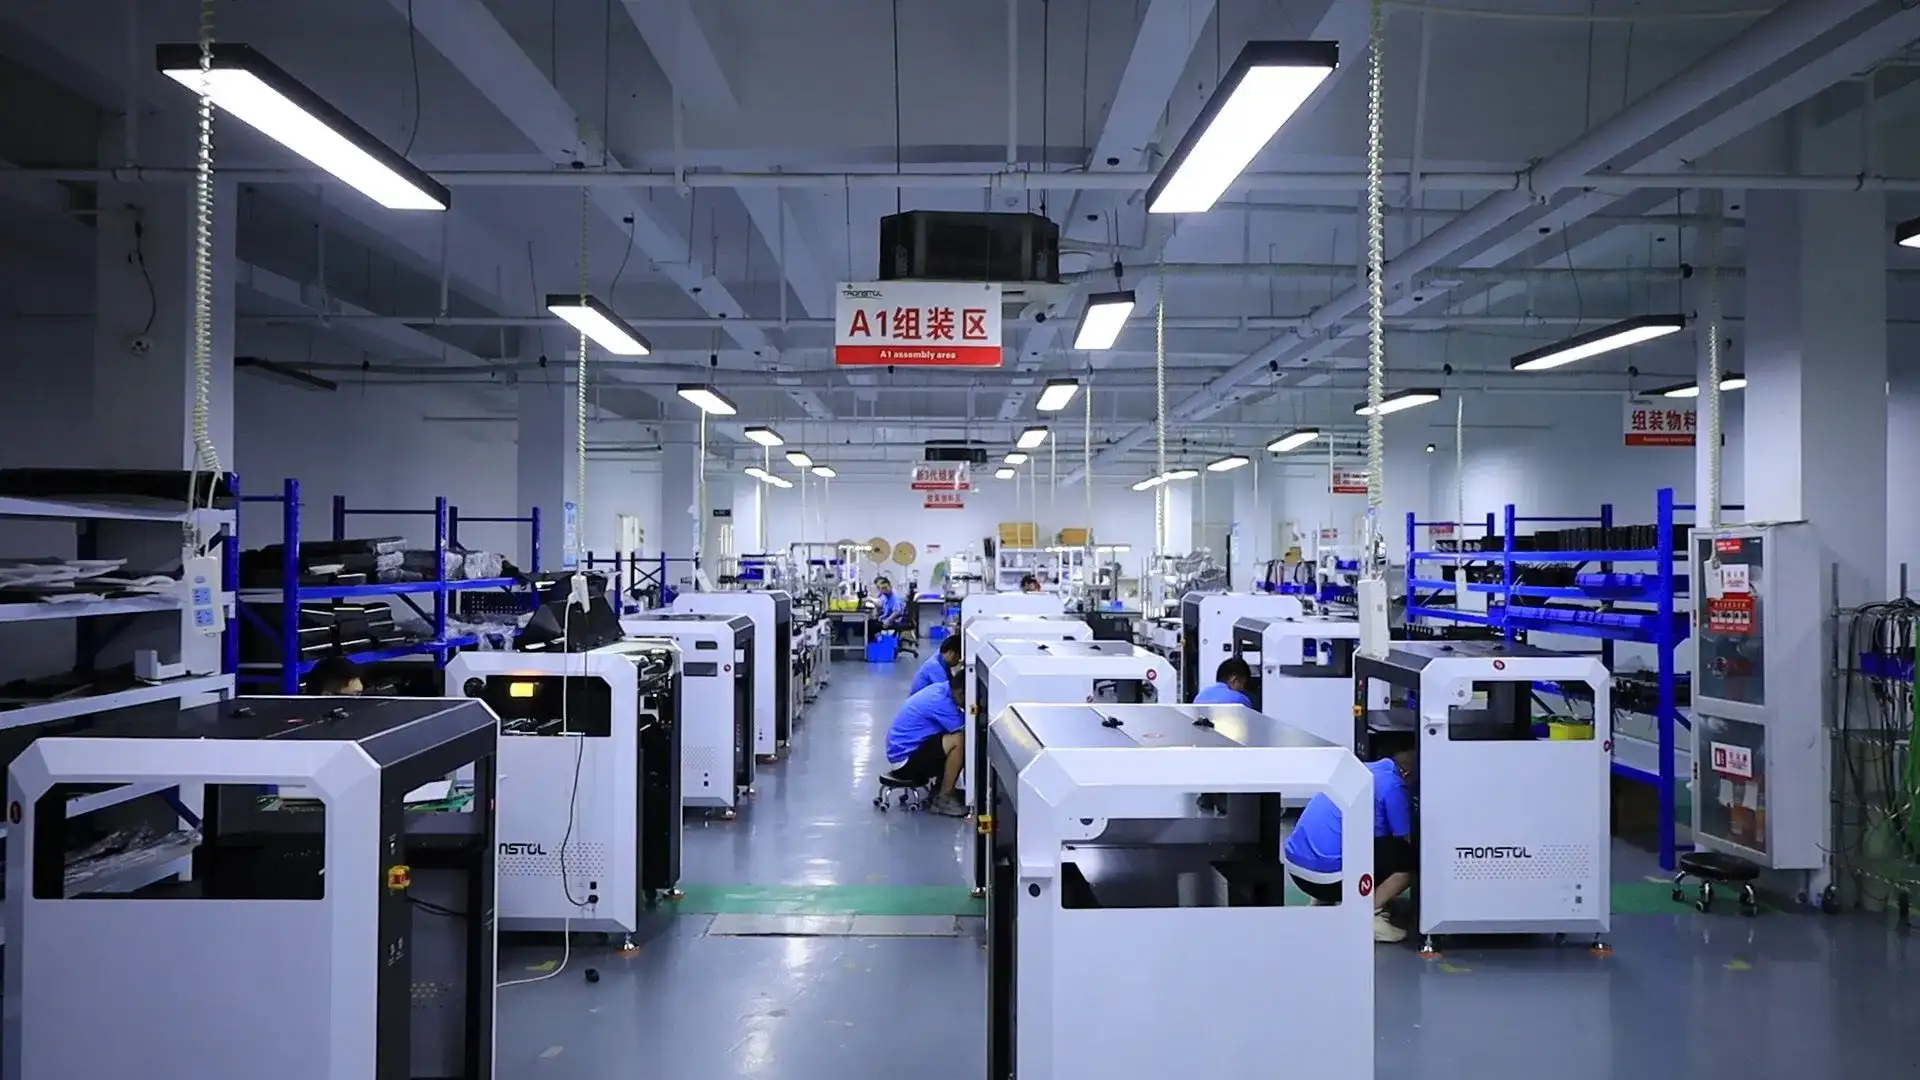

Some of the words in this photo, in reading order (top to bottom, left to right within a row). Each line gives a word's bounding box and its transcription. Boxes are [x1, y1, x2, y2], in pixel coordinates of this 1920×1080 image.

[849, 306, 988, 341] A1组装区
[880, 350, 892, 359] A1
[893, 350, 935, 361] assembly
[936, 351, 956, 360] area
[1632, 409, 1697, 431] 组装物料
[499, 842, 547, 855] NSTOL
